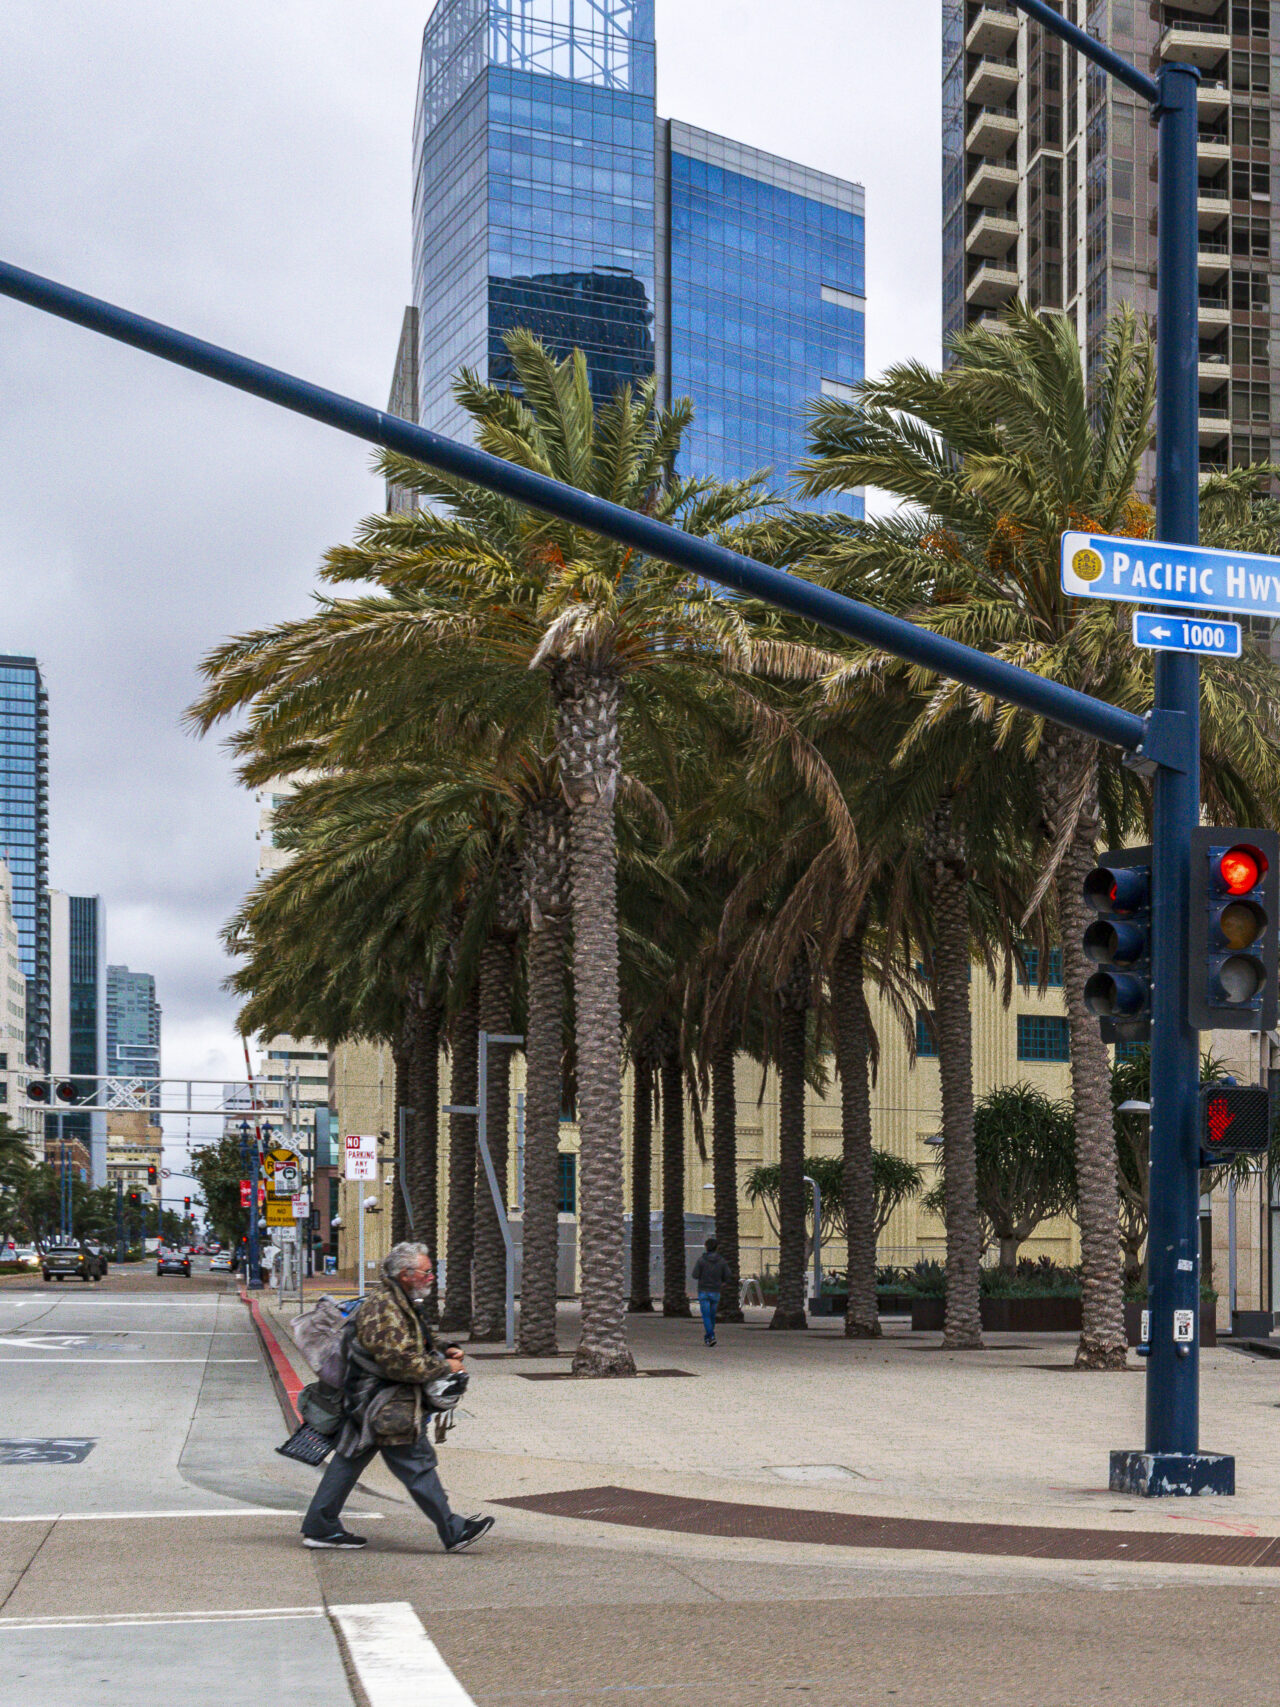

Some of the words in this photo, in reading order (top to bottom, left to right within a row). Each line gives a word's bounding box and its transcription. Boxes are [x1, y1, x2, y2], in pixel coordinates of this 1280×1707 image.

[1112, 551, 1213, 596] PACIFIC
[1182, 623, 1225, 648] 1000
[347, 1137, 359, 1147] NO
[348, 1151, 375, 1159] PARKING
